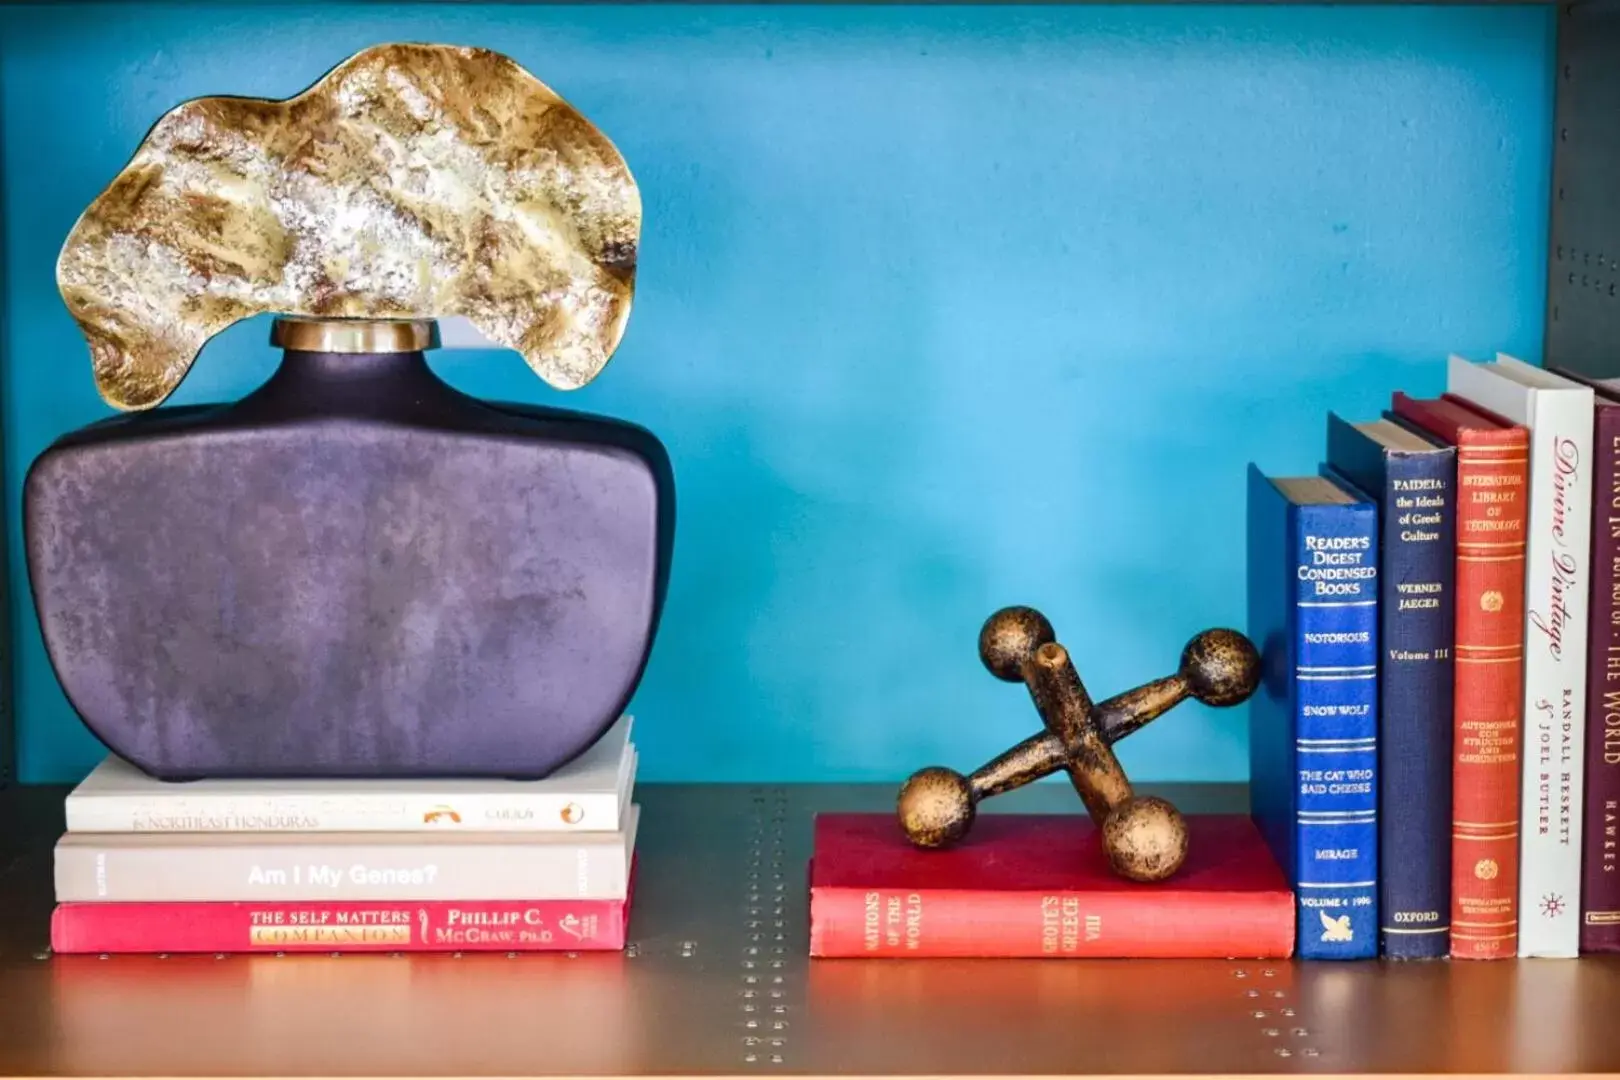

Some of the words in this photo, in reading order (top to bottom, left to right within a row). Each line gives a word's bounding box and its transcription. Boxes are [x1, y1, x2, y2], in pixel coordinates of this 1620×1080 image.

[1472, 491, 1516, 503] LIBRARY
[1551, 435, 1579, 548] Divine
[1396, 496, 1413, 507] the
[1416, 496, 1444, 507] Ideals
[1399, 514, 1411, 525] of
[1412, 513, 1442, 525] Greek
[1486, 507, 1502, 517] OF
[1305, 535, 1370, 550] READER'S
[1401, 530, 1439, 541] Culture
[1313, 551, 1362, 565] DIGEST
[1298, 565, 1377, 580] CONDENSED
[1315, 582, 1361, 595] BOOKS
[1396, 583, 1442, 594] WERNER
[1398, 599, 1440, 610] JAEGER
[1528, 549, 1577, 662] Vintage
[1304, 631, 1370, 643] NOTORIOUS
[1390, 649, 1430, 660] Volume
[1434, 648, 1449, 659] III
[1303, 705, 1338, 716] SNOW
[1338, 704, 1370, 716] WOLF
[1561, 688, 1573, 764] RANDALL
[1603, 691, 1620, 764] WORLD
[1539, 723, 1551, 766] JOEL
[1300, 770, 1322, 781] THE
[1323, 770, 1345, 781] CAT
[1346, 769, 1374, 780] WHO
[1301, 784, 1327, 794] SAID
[1539, 772, 1550, 835] BUTLER
[1560, 772, 1571, 846] HESKETT
[234, 815, 320, 829] HONDURAS
[1604, 800, 1617, 872] HAWKES
[1315, 848, 1359, 860] MIRAGE
[248, 865, 286, 885] Am
[293, 865, 301, 885] I
[308, 865, 344, 887] My
[348, 864, 438, 885] Genes?
[1301, 897, 1340, 907] VOLUME
[1341, 898, 1348, 906] 4
[447, 909, 521, 925] PHILLIP
[887, 895, 901, 925] THE
[1394, 911, 1439, 922] OXFORD
[251, 911, 284, 924] THE
[289, 911, 331, 924] SELF
[336, 911, 410, 925] MATTERS
[864, 891, 880, 952] NATIONS
[905, 893, 921, 950] WORLD
[1062, 896, 1078, 952] GREECE
[256, 928, 405, 942] COMPANION
[886, 928, 900, 947] OF
